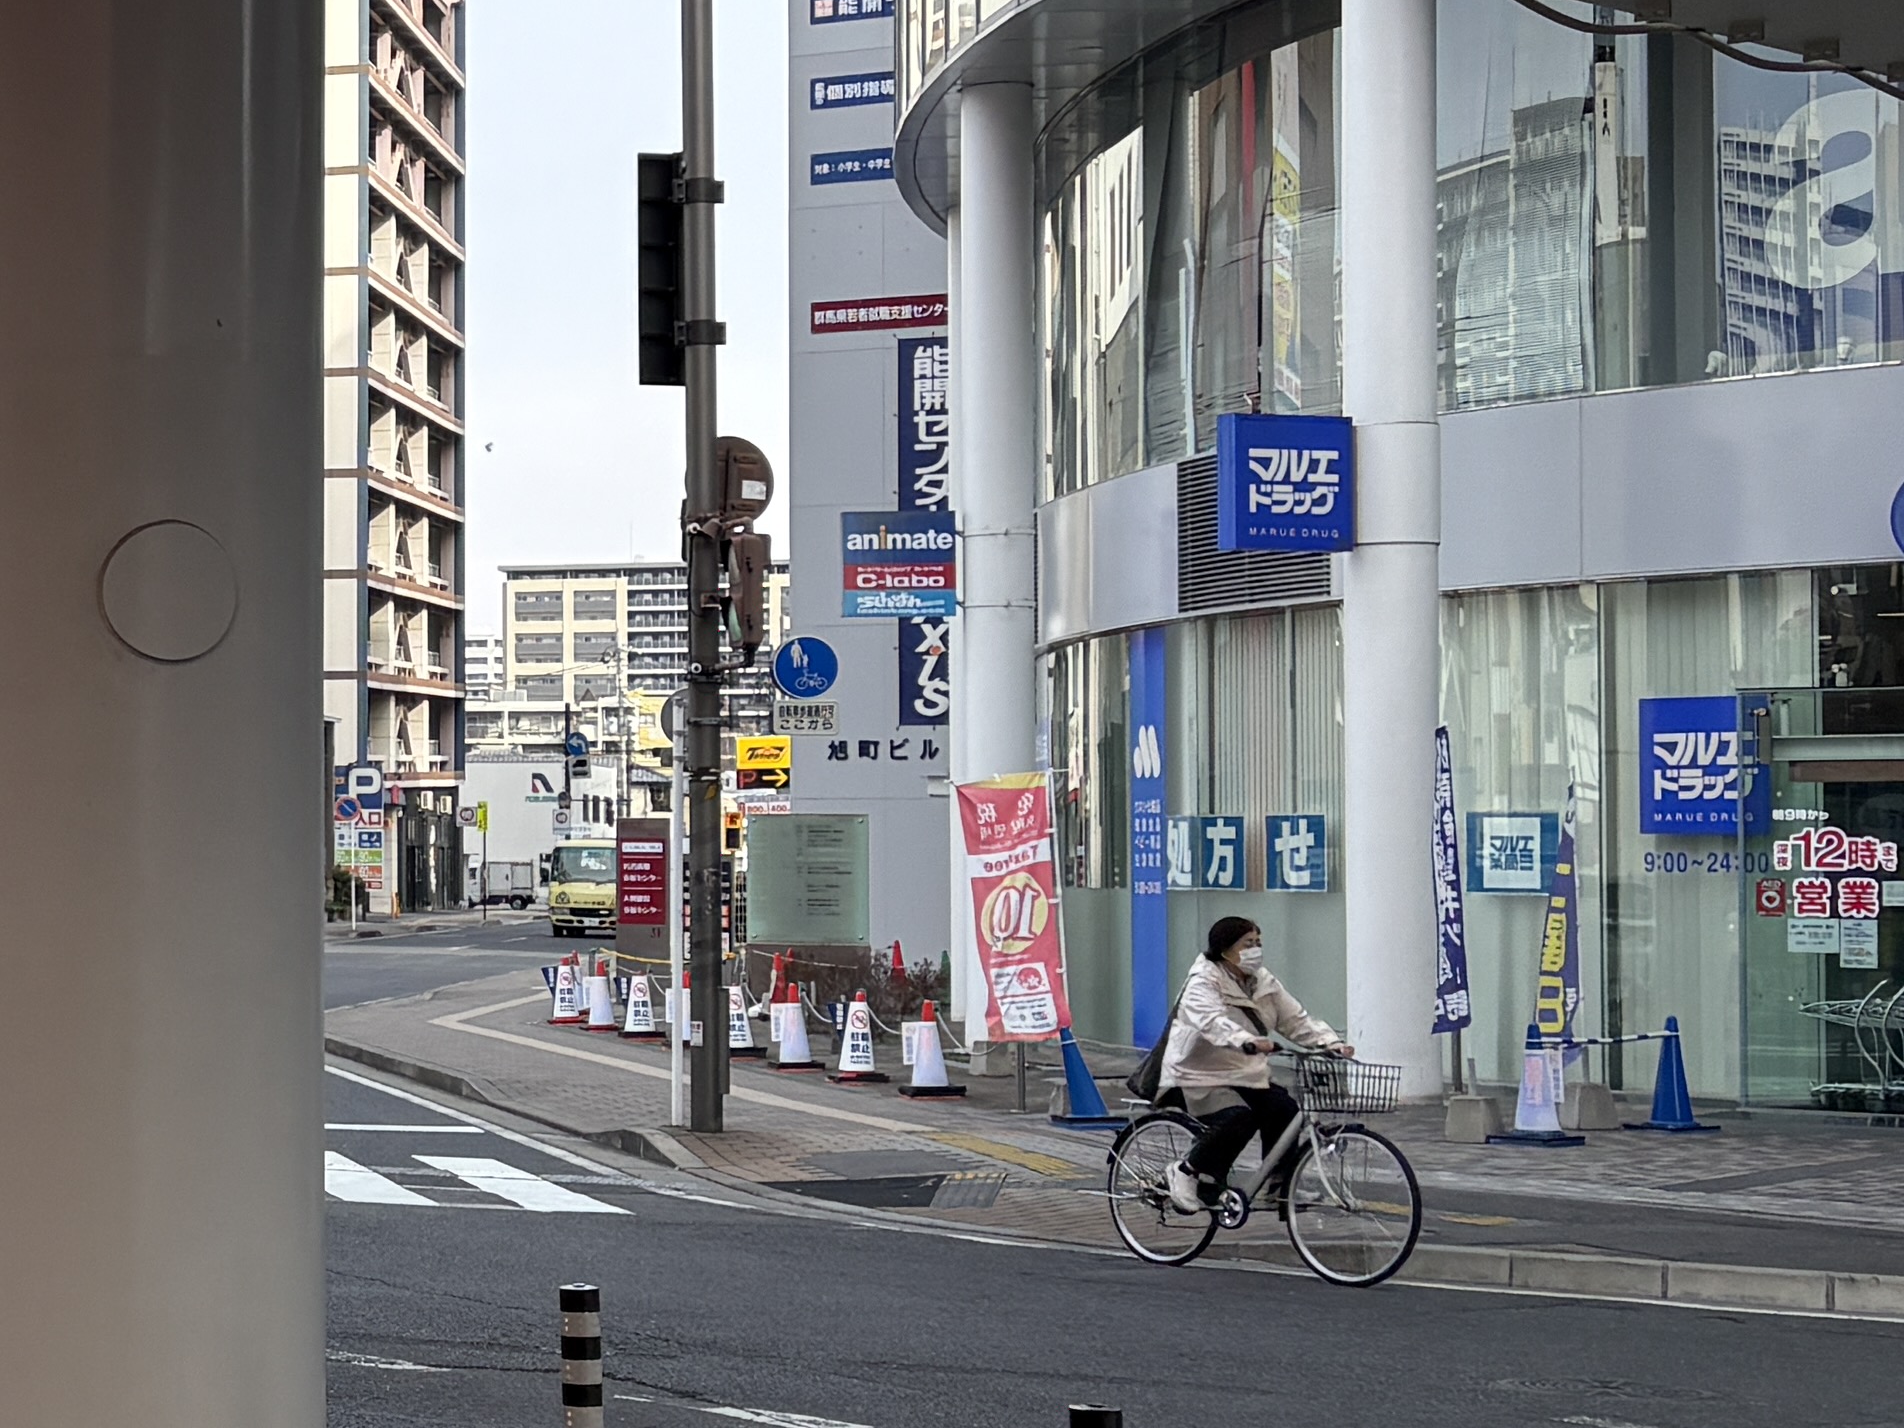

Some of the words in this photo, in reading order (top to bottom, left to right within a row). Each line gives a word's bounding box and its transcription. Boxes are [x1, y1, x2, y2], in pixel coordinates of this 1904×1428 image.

[914, 345, 949, 512] 能開センタ
[1248, 447, 1340, 484] マルエ
[1248, 483, 1340, 516] ドラッグ
[847, 525, 953, 550] animate
[1249, 527, 1296, 537] MARUE
[1301, 528, 1339, 539] DRUG
[857, 573, 945, 588] C-labo
[779, 719, 834, 731] ここから
[828, 738, 940, 761] 旭町ビル
[1653, 731, 1754, 766] マルエ
[349, 768, 381, 798] P
[1653, 767, 1759, 801] ドラッグ
[1654, 812, 1703, 822] MARUE
[1644, 852, 1769, 873] 9:00~24:00
[1792, 828, 1879, 871] 12時
[1793, 878, 1880, 918] 営業
